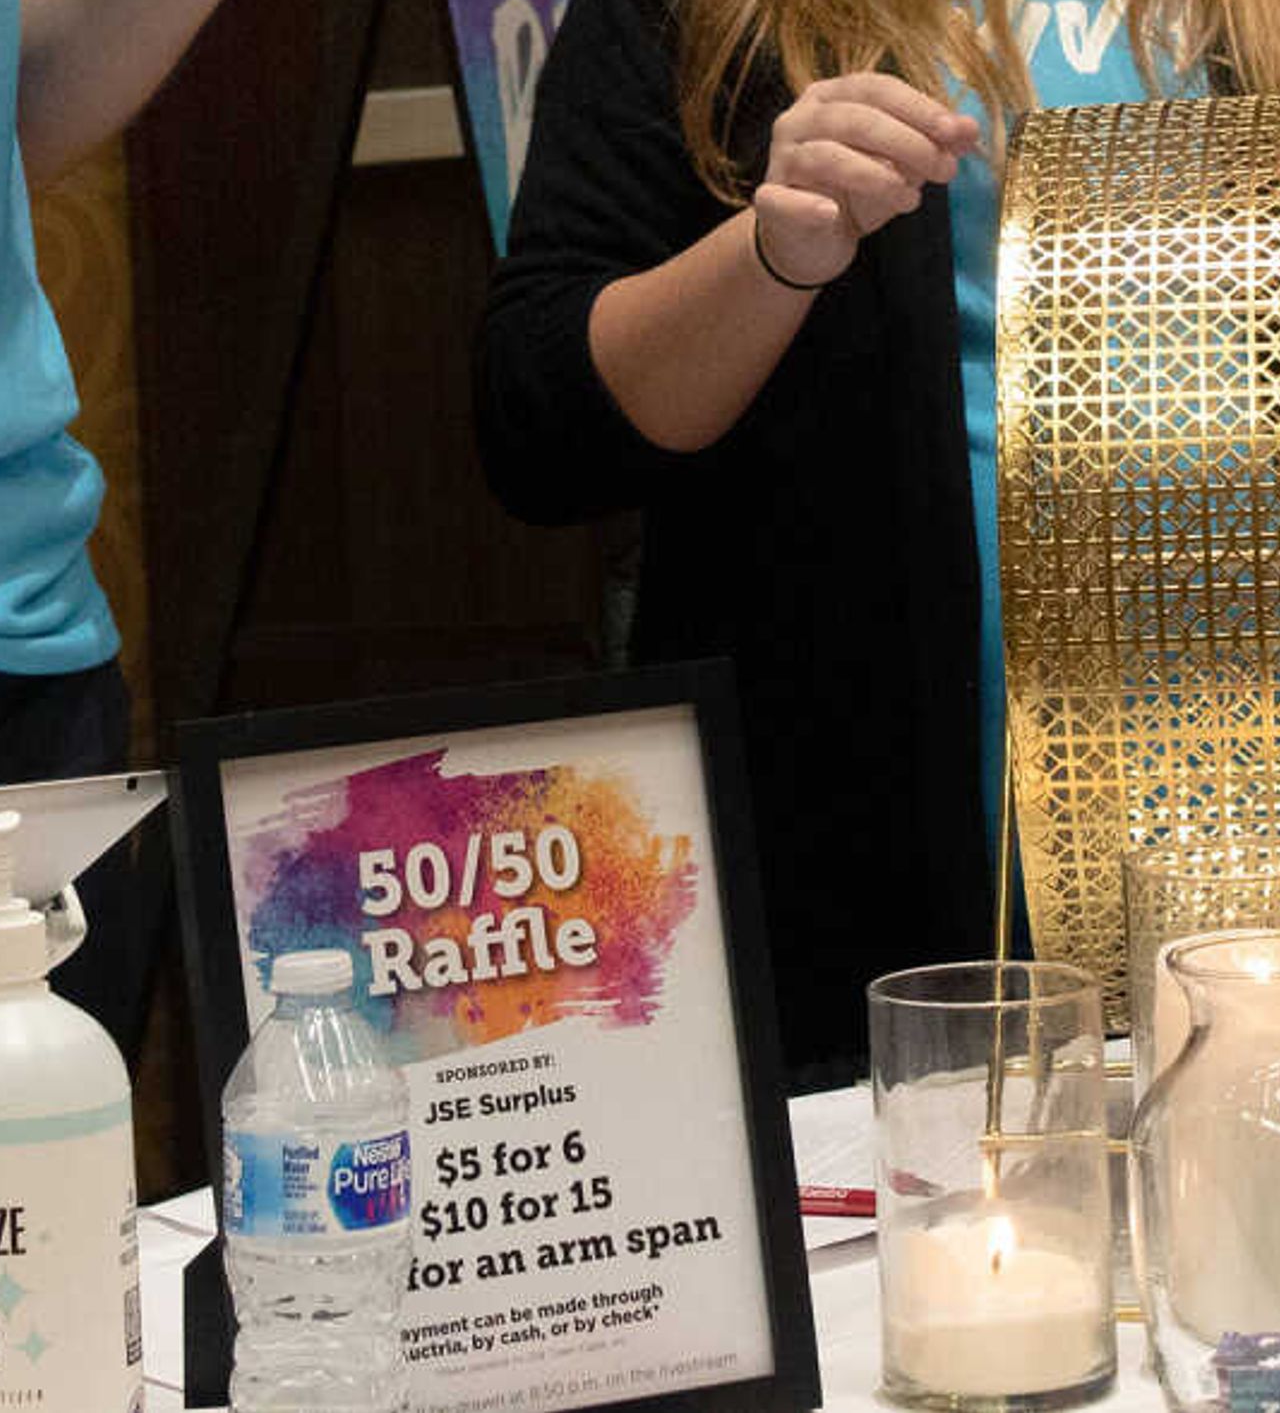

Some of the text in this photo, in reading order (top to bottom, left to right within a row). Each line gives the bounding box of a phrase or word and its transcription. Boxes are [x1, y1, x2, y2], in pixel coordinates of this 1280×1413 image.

[356, 825, 580, 916] 50/50
[361, 906, 598, 996] Raffle
[435, 1057, 529, 1084] SPONSORED
[424, 1084, 577, 1125] JSE Surplus
[333, 1167, 390, 1196] Pure
[435, 1130, 587, 1188] $5 for 6
[420, 1176, 613, 1242] $10 for 15
[476, 1249, 526, 1280] an
[536, 1233, 617, 1270] arm
[626, 1215, 723, 1260] span
[400, 1284, 664, 1344] ayment can be made through
[471, 1334, 495, 1352] by
[500, 1324, 546, 1345] cash,
[550, 1321, 569, 1336] or
[573, 1315, 597, 1333] by
